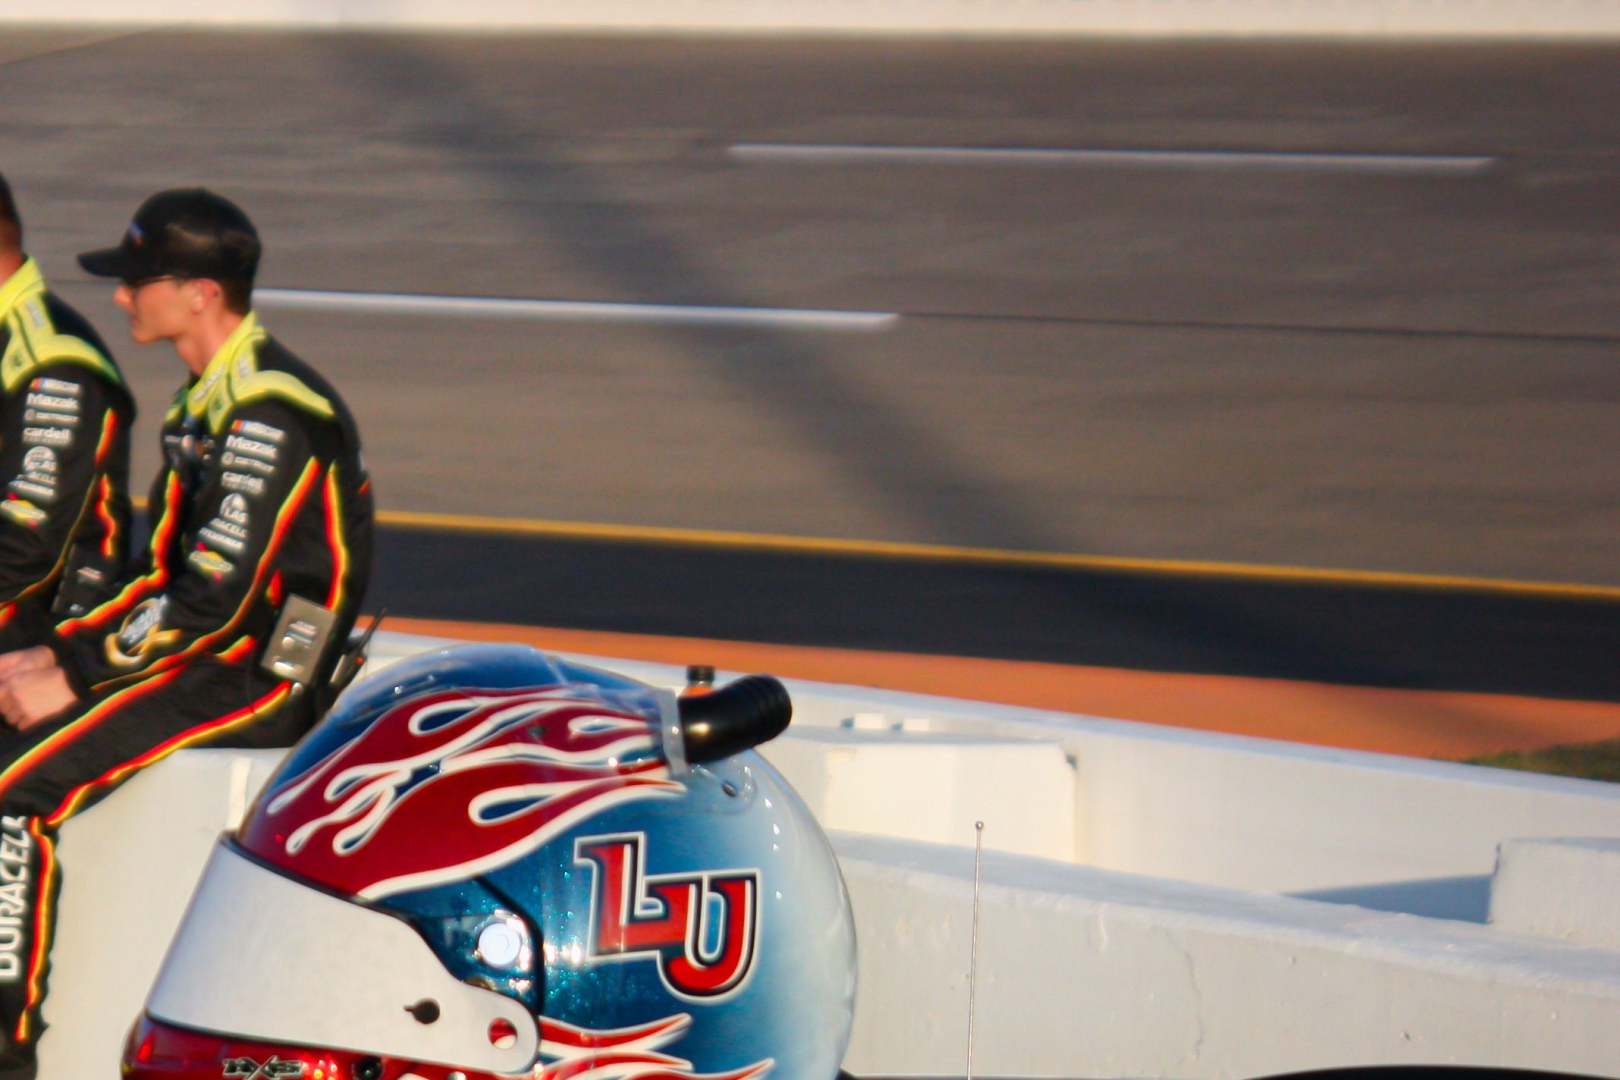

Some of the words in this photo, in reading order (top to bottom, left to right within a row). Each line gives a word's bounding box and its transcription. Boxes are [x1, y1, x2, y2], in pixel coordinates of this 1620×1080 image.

[27, 393, 79, 411] Mazak
[23, 426, 71, 439] cardell
[225, 434, 277, 459] Mazak
